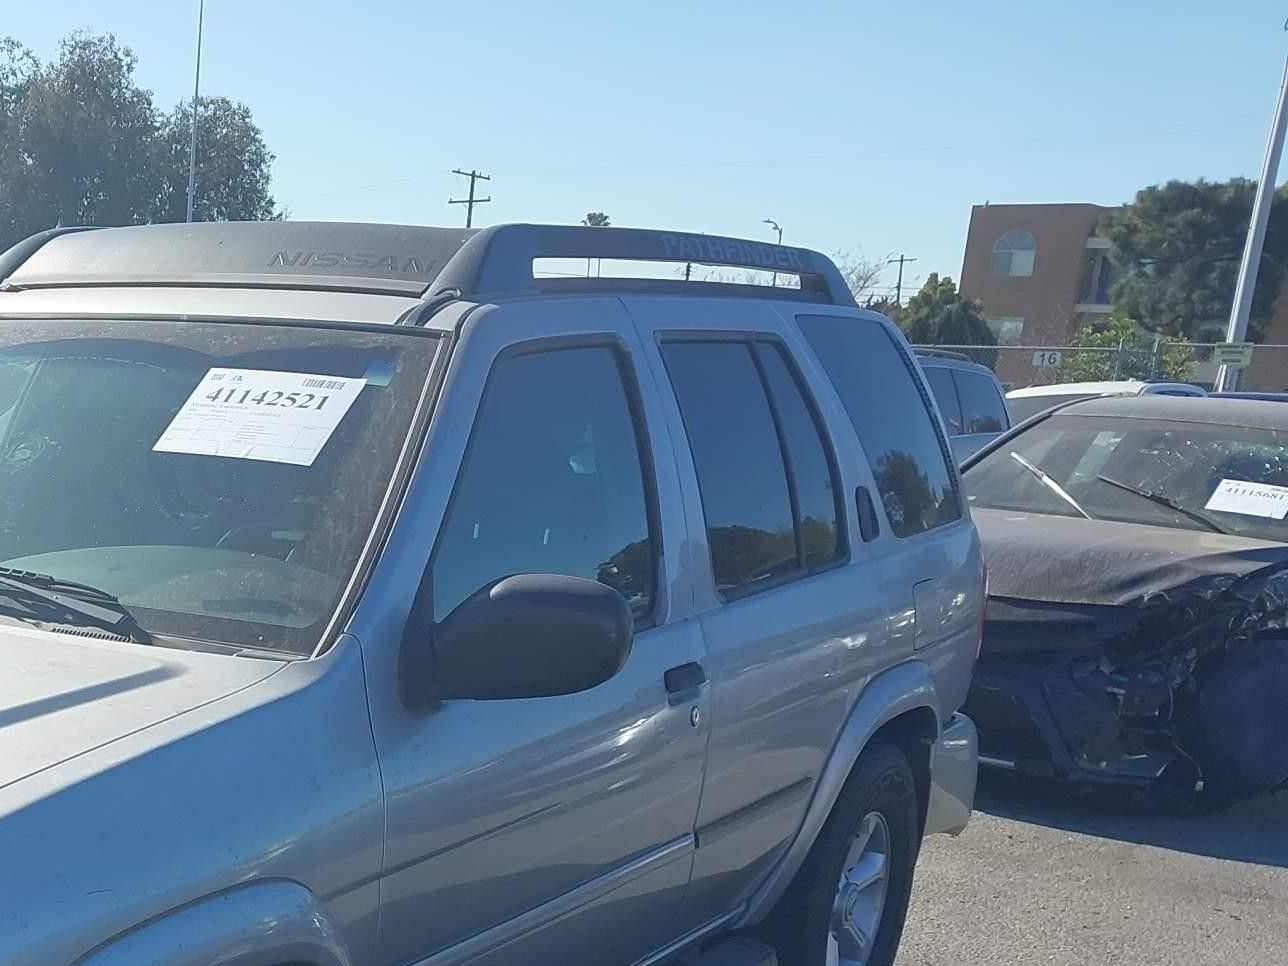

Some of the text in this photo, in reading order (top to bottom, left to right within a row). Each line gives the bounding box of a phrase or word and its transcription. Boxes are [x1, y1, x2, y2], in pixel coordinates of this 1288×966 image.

[267, 250, 438, 273] NISSAN
[662, 233, 802, 267] PATHFINDER
[1039, 352, 1057, 365] 16
[206, 386, 330, 411] 41142521
